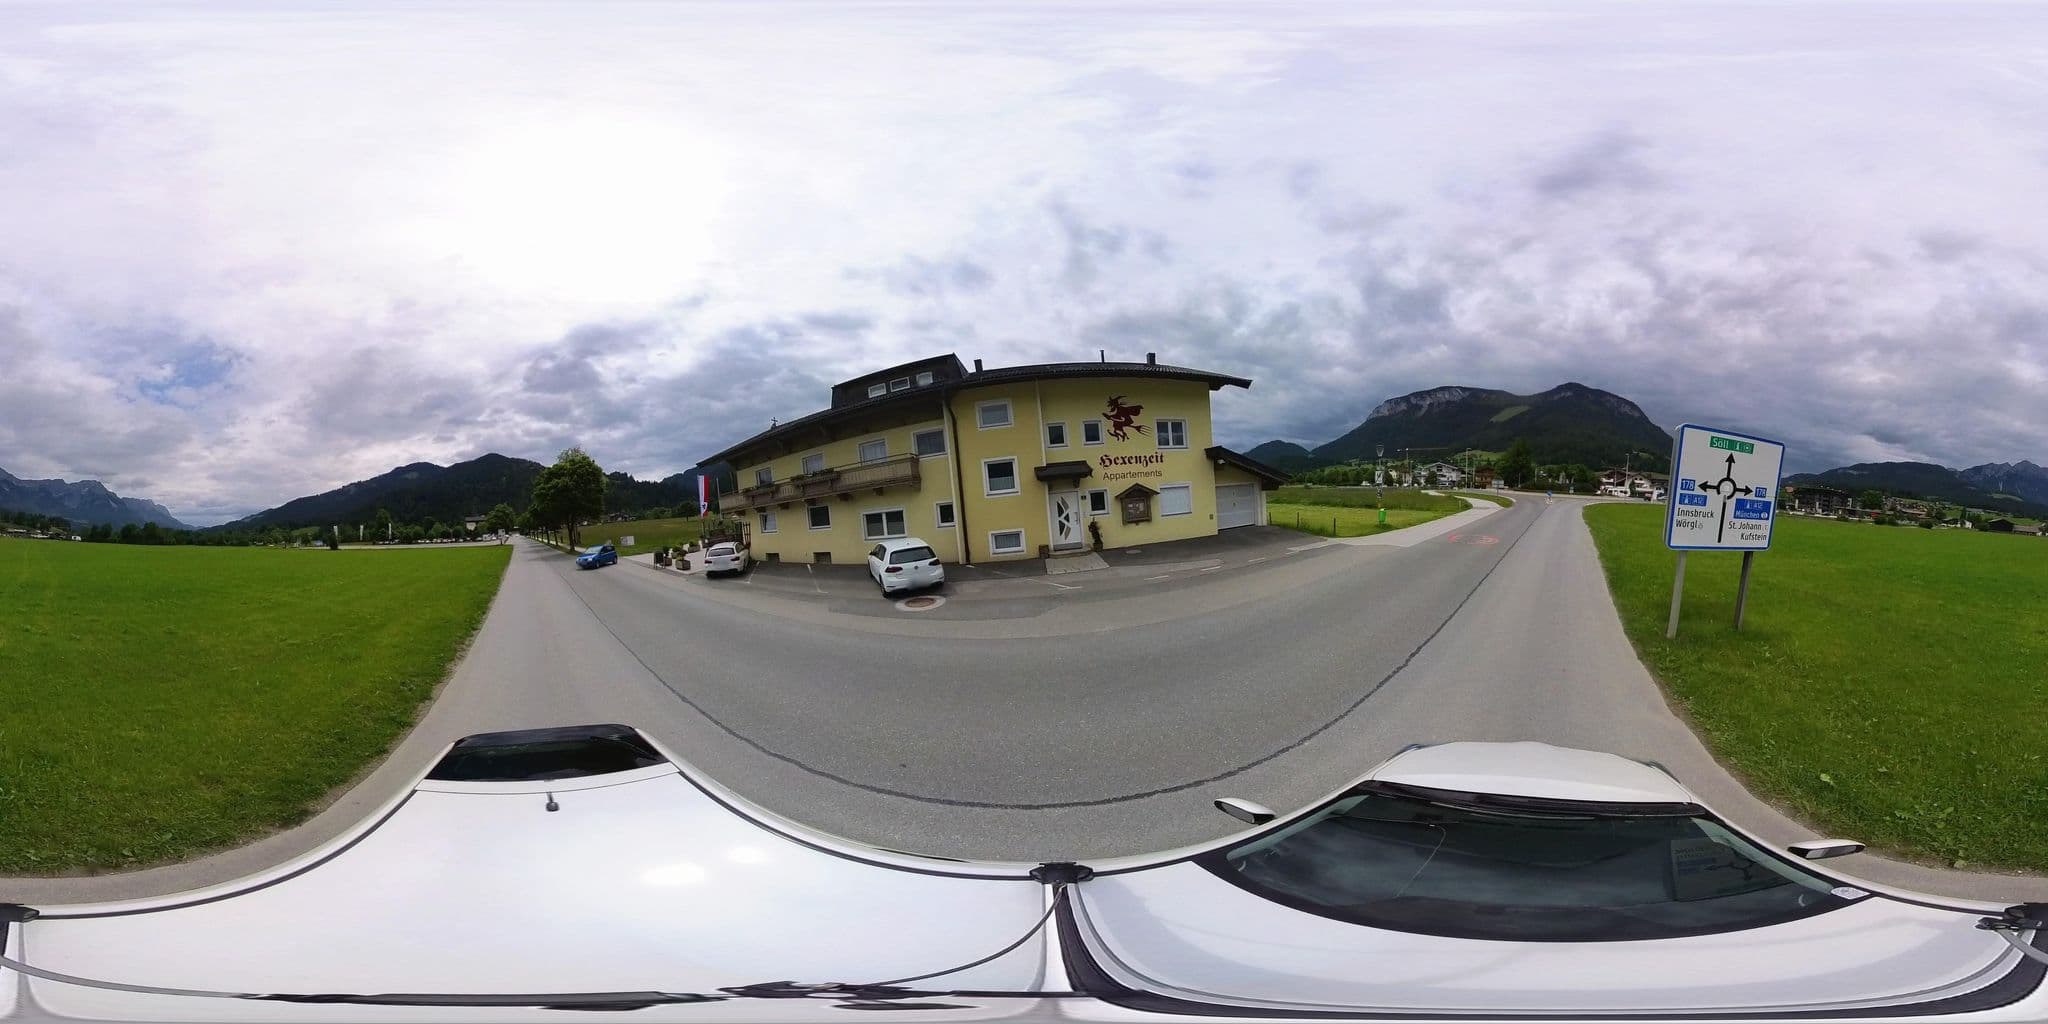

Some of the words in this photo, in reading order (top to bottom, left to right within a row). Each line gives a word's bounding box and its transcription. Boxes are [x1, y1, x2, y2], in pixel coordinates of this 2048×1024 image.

[1713, 438, 1729, 449] Söll
[1099, 452, 1163, 468] Hexenzeit
[1103, 470, 1162, 481] Appartements
[1682, 480, 1694, 490] 178
[1756, 488, 1766, 497] 178
[1677, 508, 1714, 518] Innsbruck
[1736, 510, 1760, 518] München
[1676, 519, 1697, 530] Wörgl
[1728, 521, 1737, 529] St.
[1738, 521, 1761, 530] Johann
[1740, 532, 1767, 541] Kufstein
